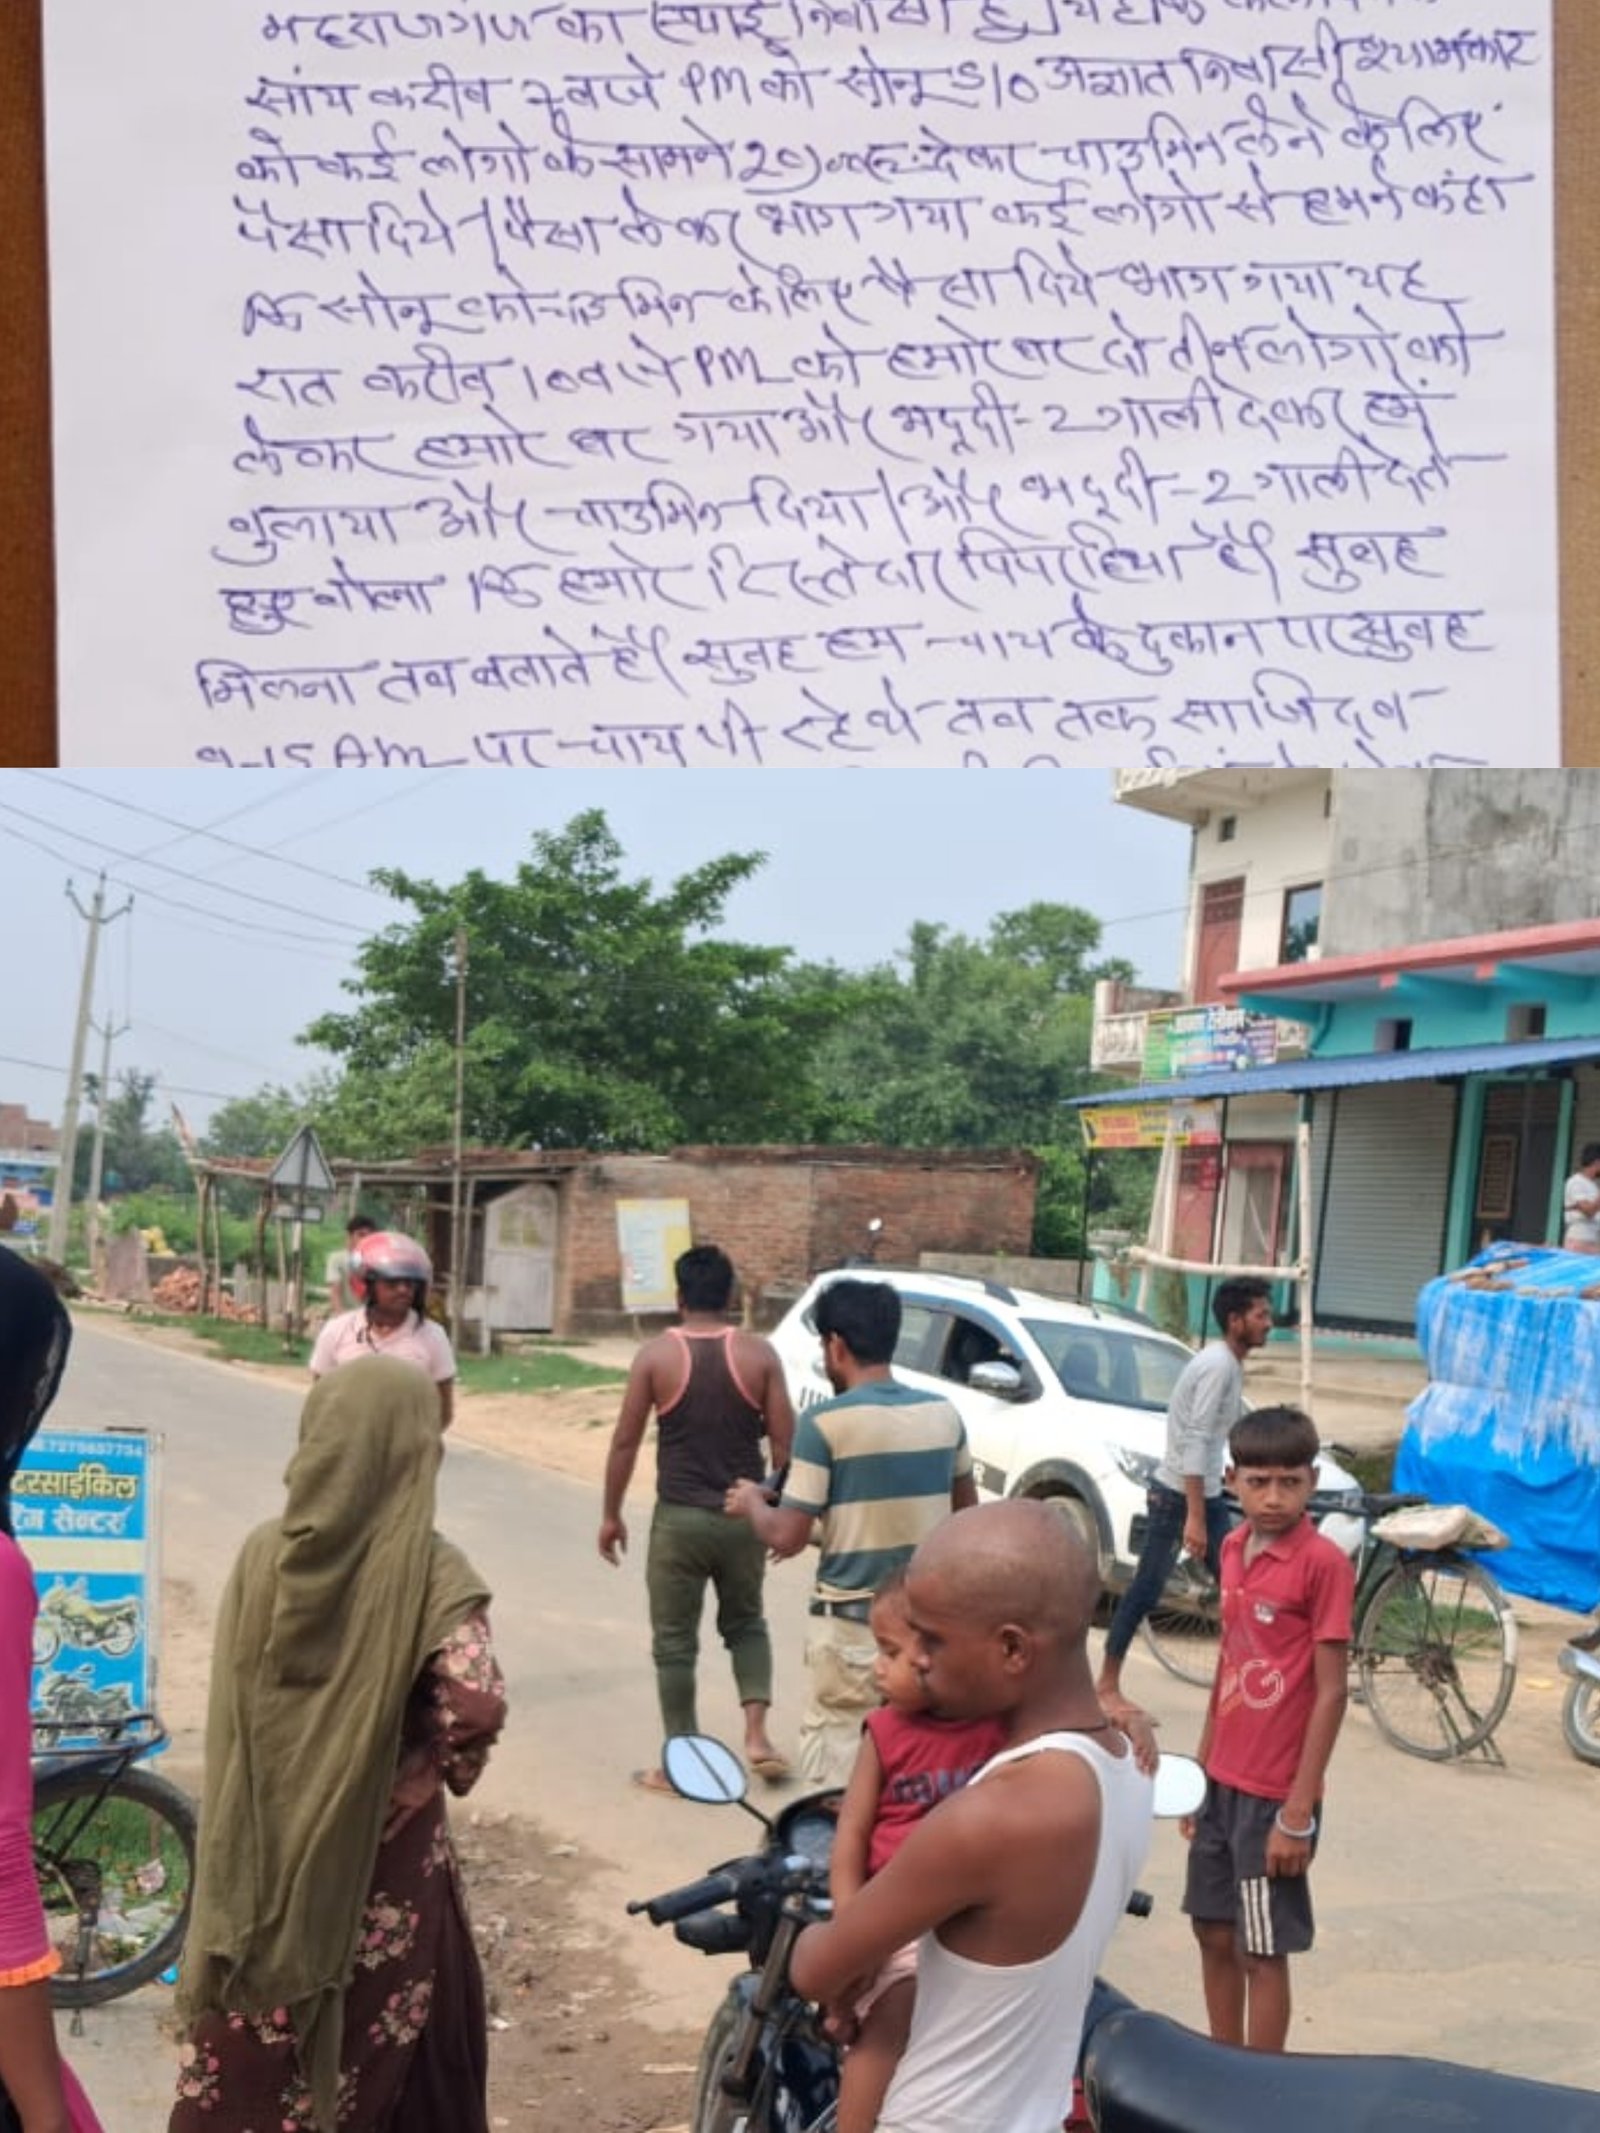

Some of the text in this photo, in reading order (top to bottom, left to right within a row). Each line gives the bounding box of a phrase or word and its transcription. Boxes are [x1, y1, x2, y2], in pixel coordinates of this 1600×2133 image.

[680, 61, 752, 105] PM
[759, 40, 830, 109] को
[235, 127, 318, 187] को
